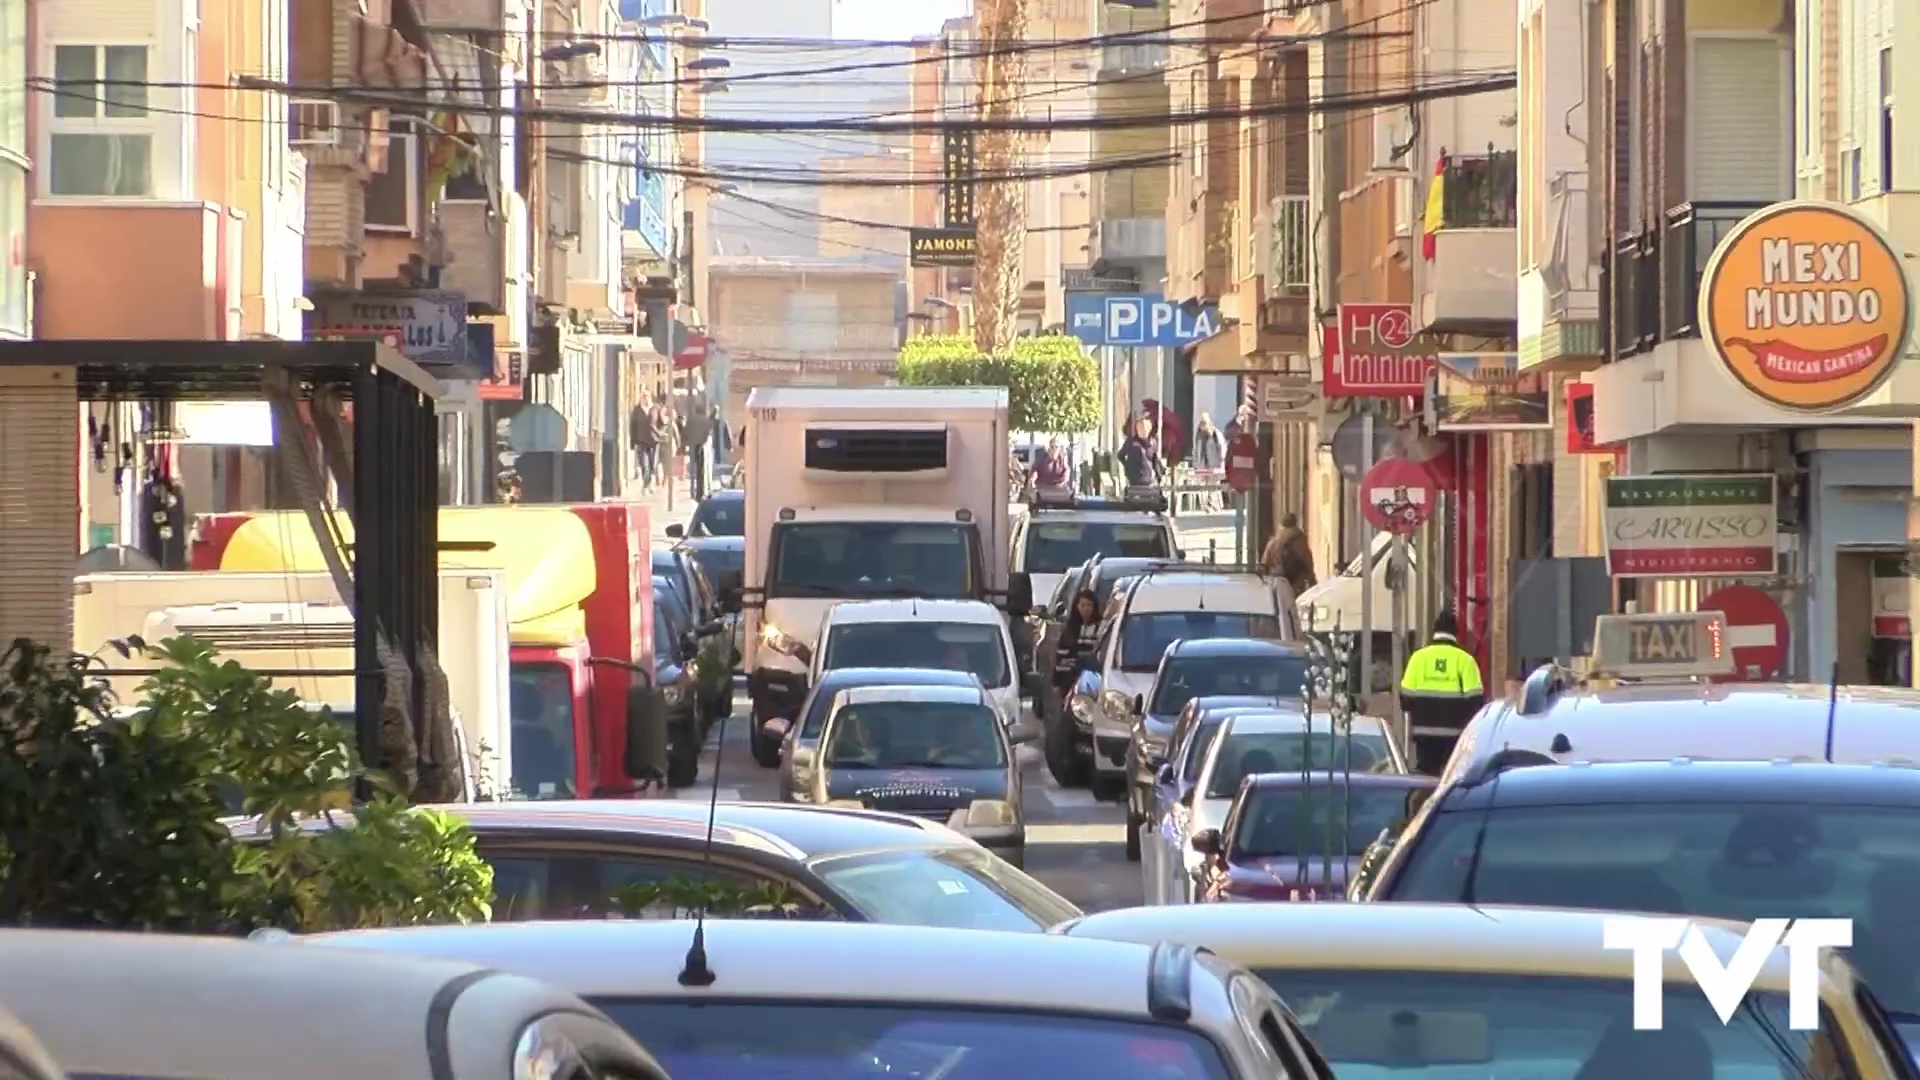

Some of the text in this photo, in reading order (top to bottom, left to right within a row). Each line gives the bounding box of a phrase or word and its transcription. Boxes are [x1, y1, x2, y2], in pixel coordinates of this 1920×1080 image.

[1762, 237, 1860, 285] MEXI
[1110, 303, 1221, 338] P PLA
[1746, 287, 1880, 330] MUNDO
[1767, 346, 1873, 374] MEXICAN CANTINA
[1621, 488, 1759, 499] RESTAURANTE
[1614, 513, 1769, 541] CARUSSO
[1630, 621, 1696, 660] TAXI
